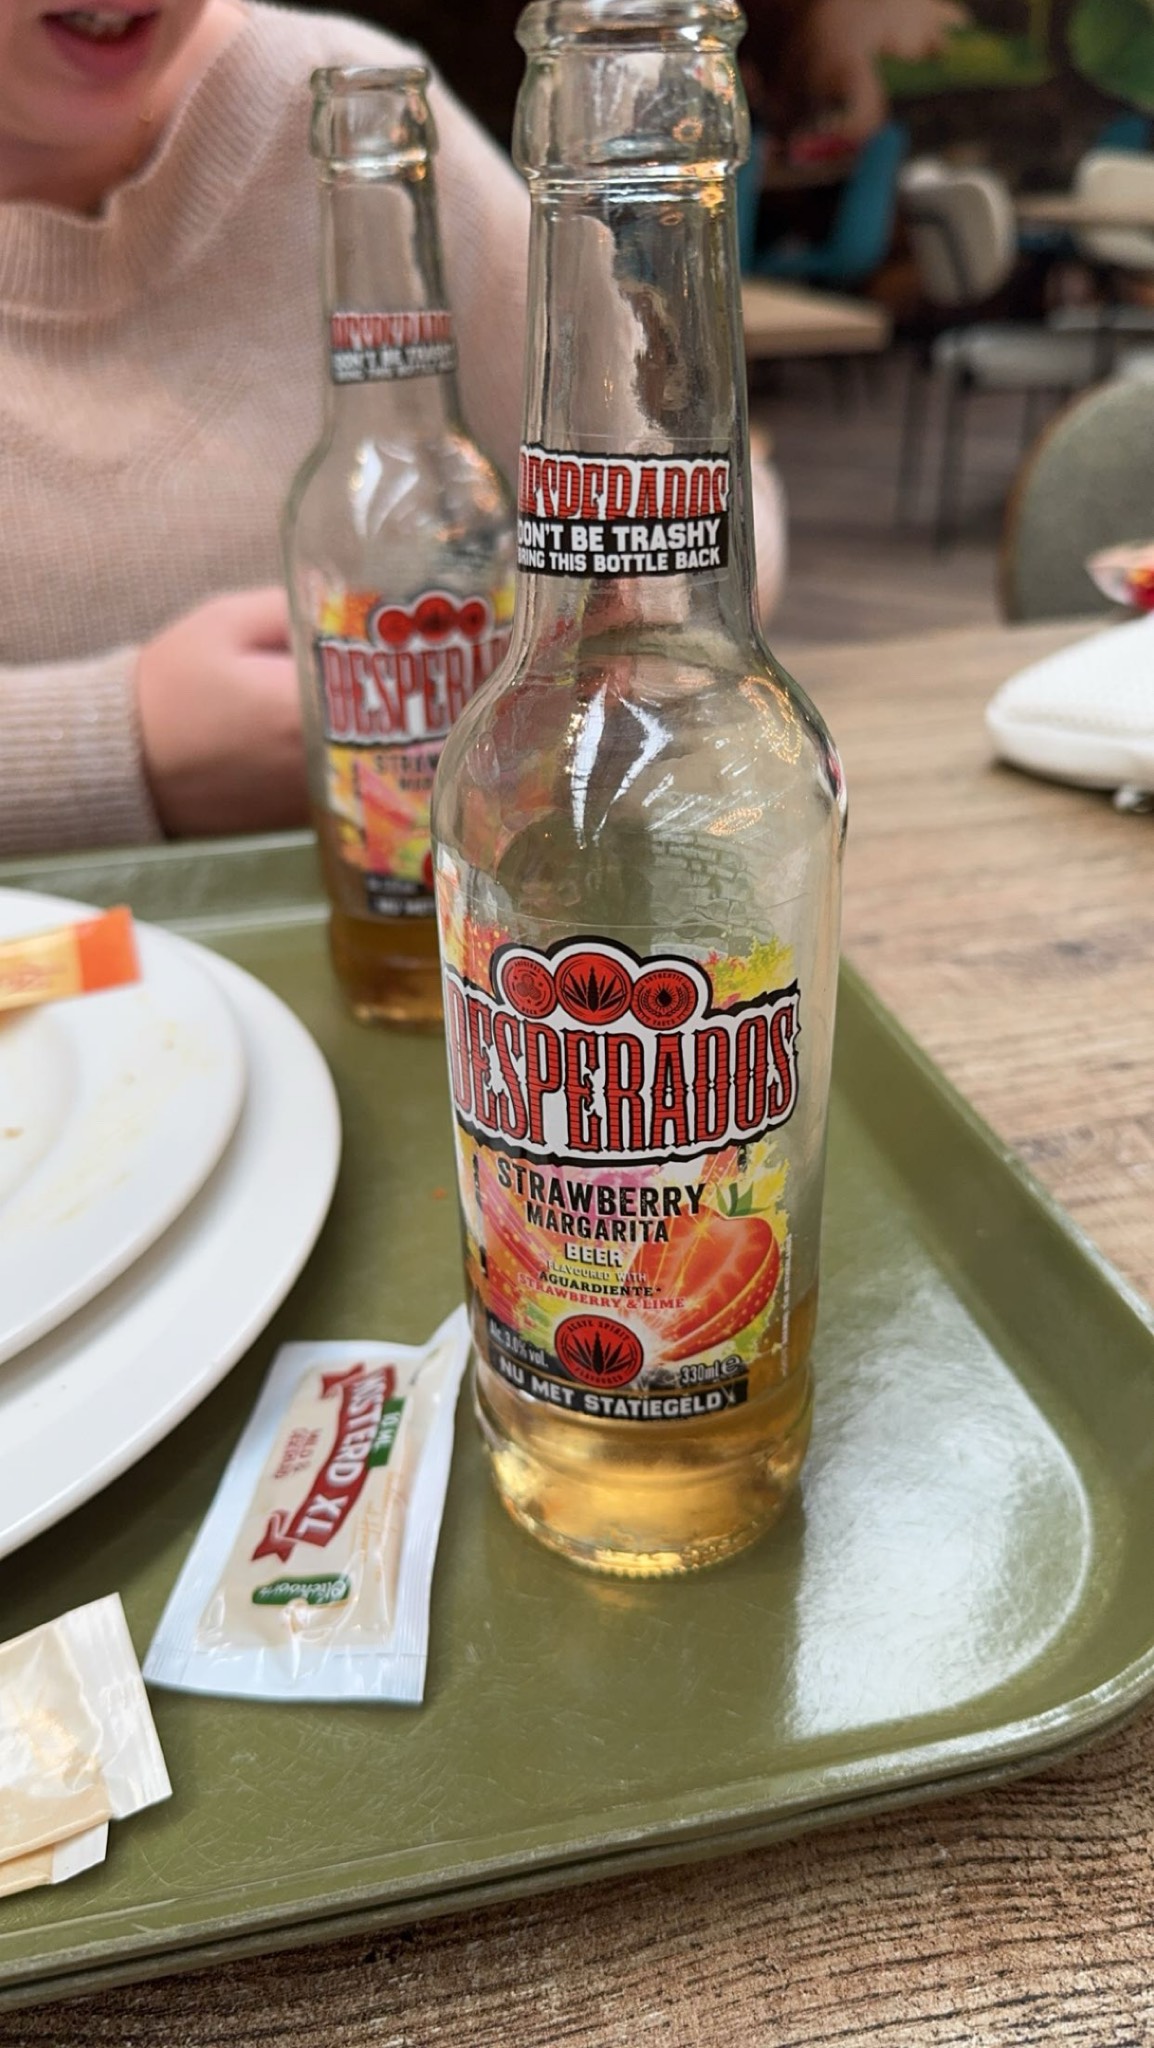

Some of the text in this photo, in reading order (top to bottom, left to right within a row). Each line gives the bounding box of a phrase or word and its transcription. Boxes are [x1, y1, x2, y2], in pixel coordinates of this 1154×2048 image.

[571, 524, 605, 552] BE
[611, 518, 720, 552] TRASHY
[549, 551, 587, 572] THIS
[594, 552, 669, 573] BOTTLE
[675, 547, 720, 570] BACK
[447, 978, 796, 1153] DESPERADOS
[497, 1156, 707, 1217] STRAWBERRY
[527, 1200, 669, 1243] MARGARITA
[546, 1260, 647, 1284] FLAVOURED WITH
[564, 1242, 622, 1268] BEER
[518, 1272, 685, 1310] STRAWBERRY & LIME
[500, 1355, 722, 1417] NU MET STATIEGELD
[297, 1494, 349, 1537] XL
